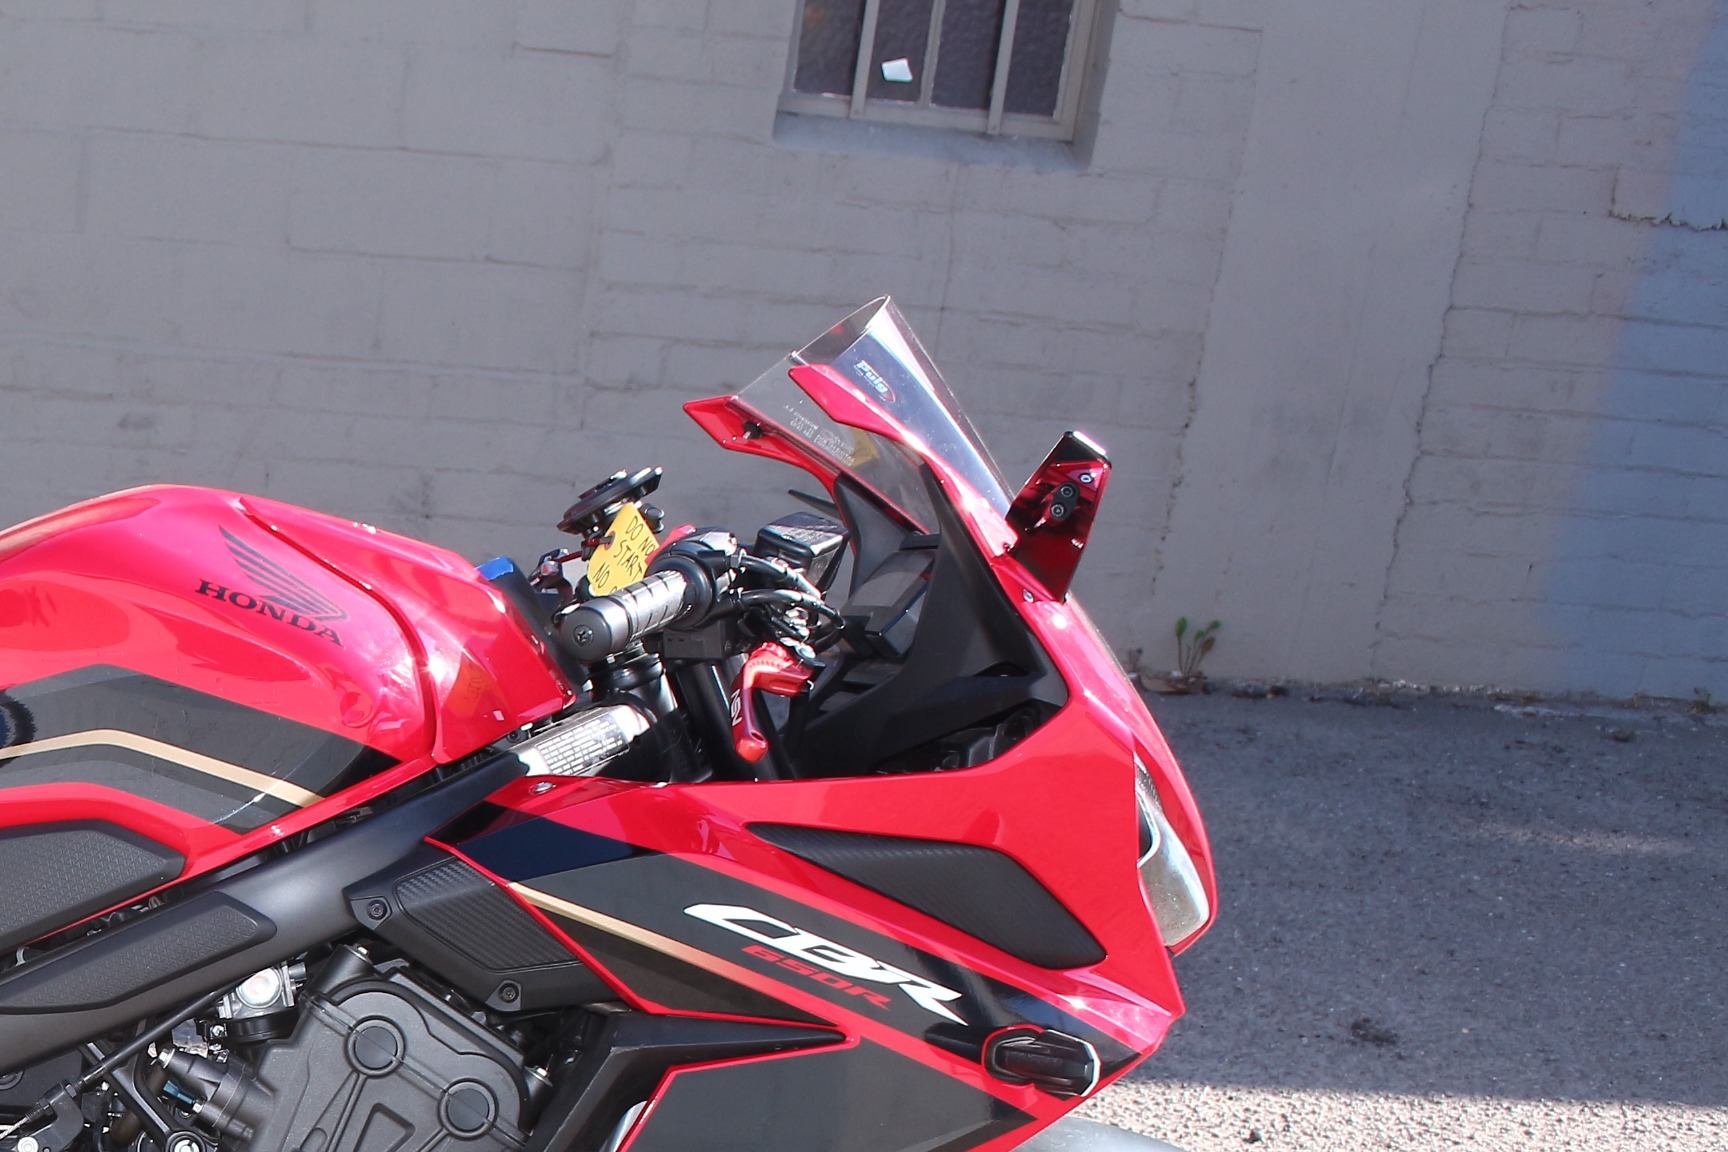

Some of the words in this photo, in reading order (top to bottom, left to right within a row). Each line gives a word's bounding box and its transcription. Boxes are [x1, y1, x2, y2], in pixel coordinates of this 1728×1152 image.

[613, 539, 643, 583] START
[625, 515, 644, 540] DO
[638, 537, 656, 557] NO
[592, 562, 611, 588] NO
[194, 578, 345, 647] HONDA
[682, 901, 969, 1027] CBR
[741, 944, 892, 1011] 650R
